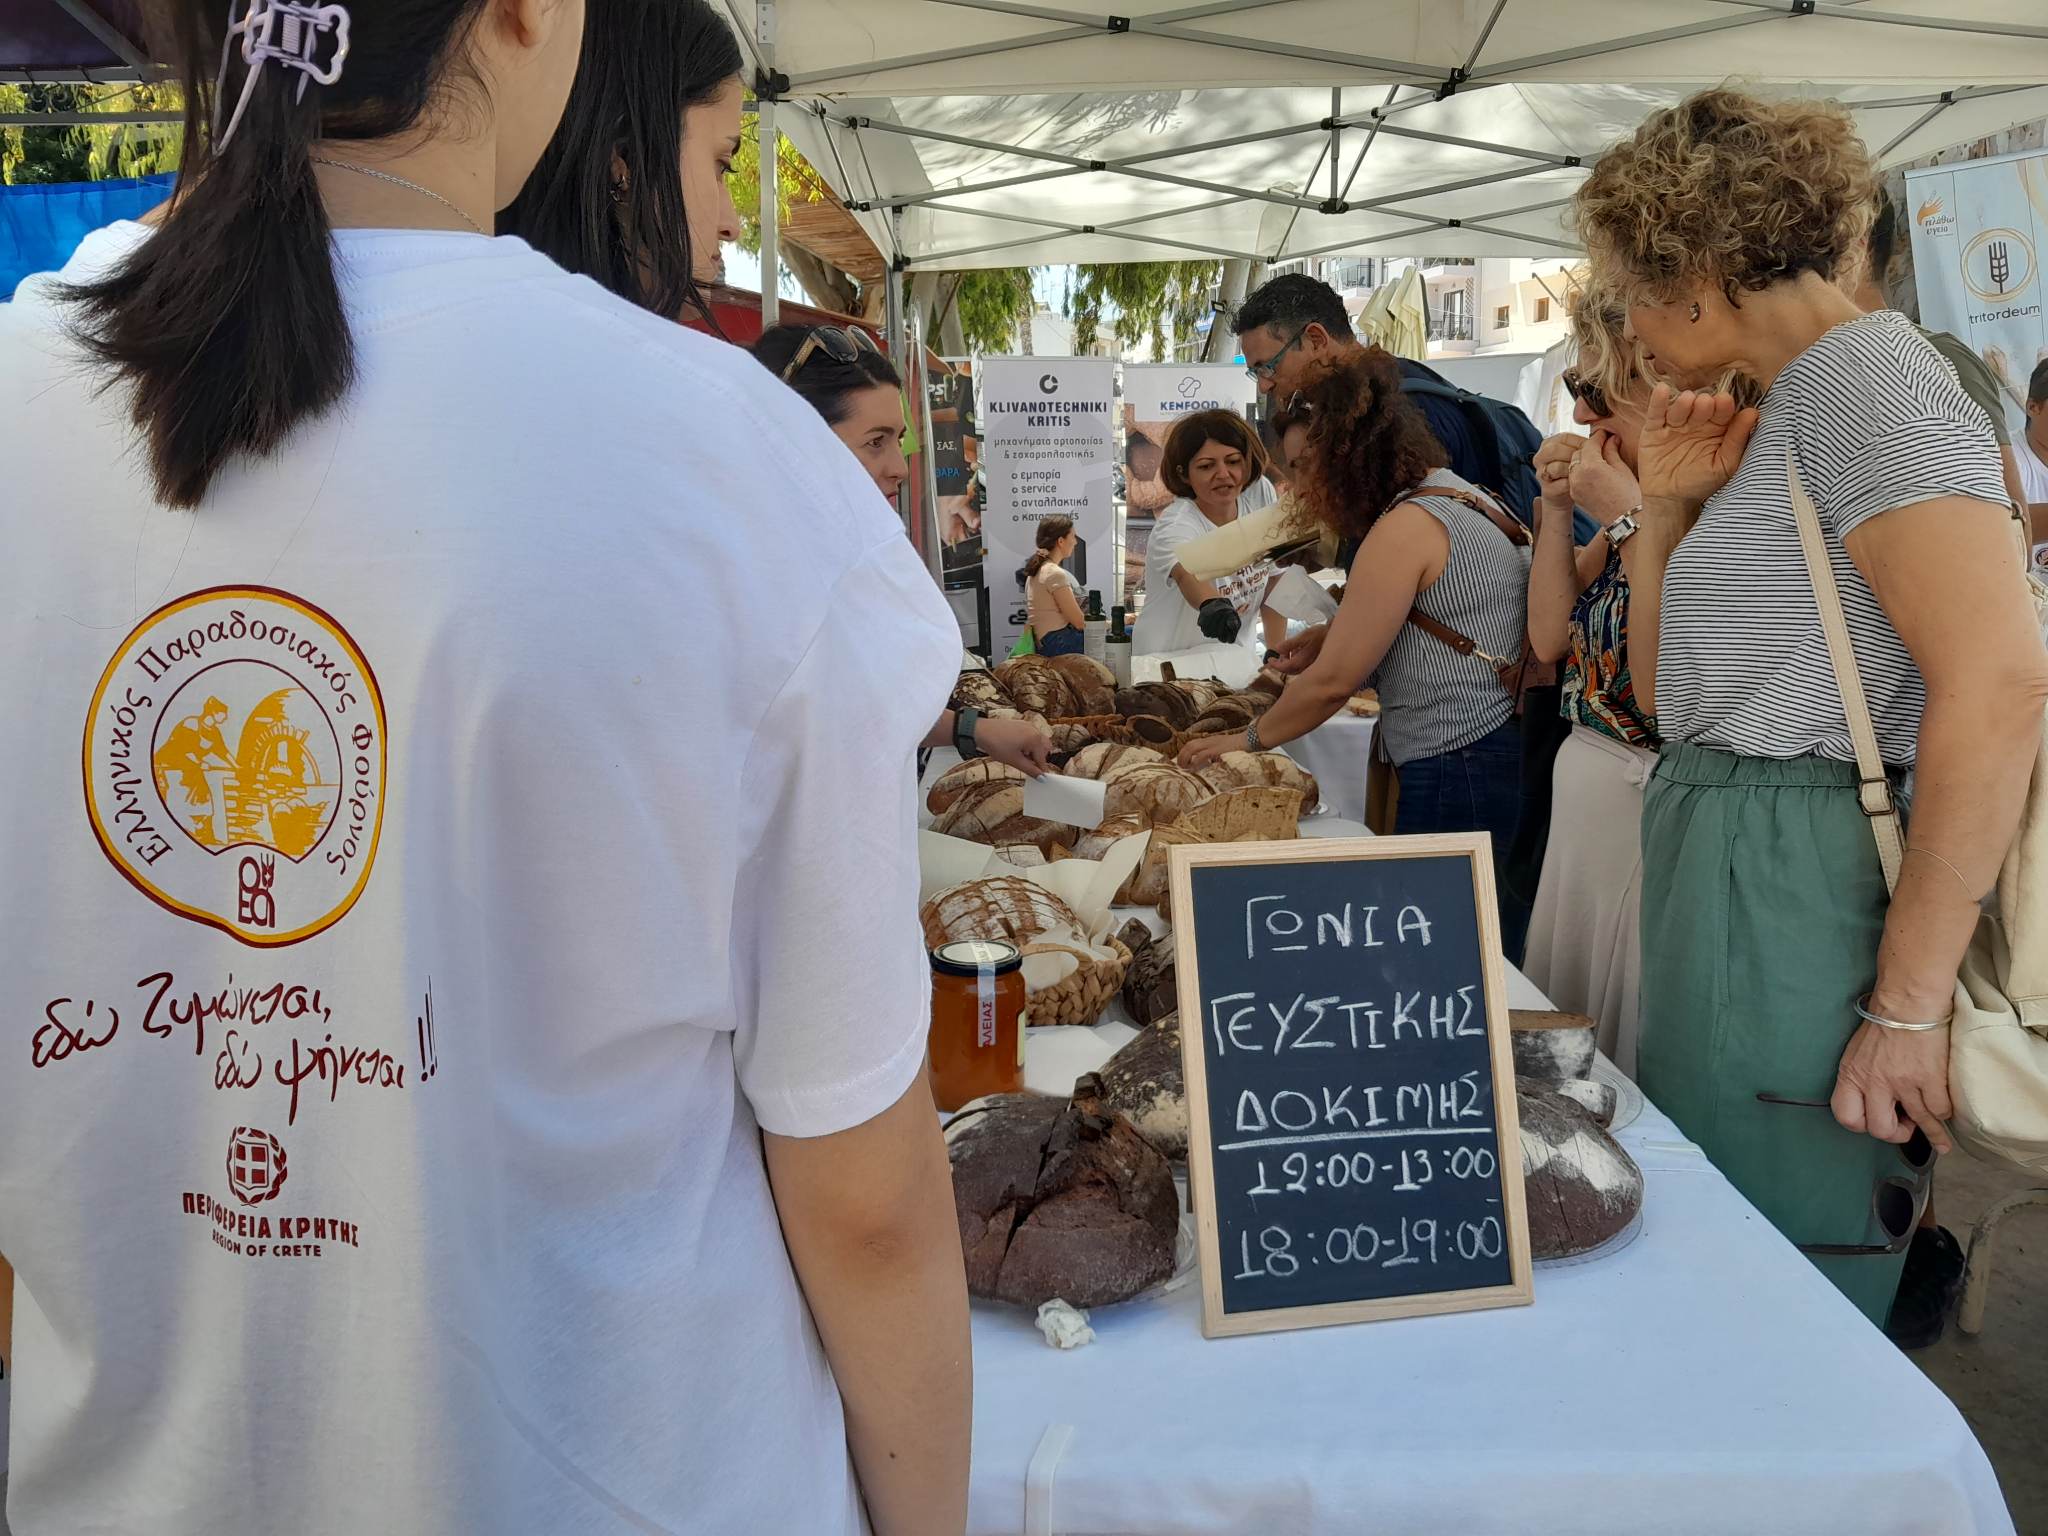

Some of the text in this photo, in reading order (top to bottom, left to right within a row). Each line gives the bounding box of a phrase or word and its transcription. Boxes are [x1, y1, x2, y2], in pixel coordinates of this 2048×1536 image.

[1968, 304, 2040, 325] tritordeum
[989, 401, 1107, 413] KLIVANOTECHNIKI
[1160, 400, 1219, 411] KENFOOD
[1028, 415, 1071, 427] KRITIS
[994, 437, 1051, 448] μηχανήματα
[1012, 449, 1095, 460] ζαχαροπλαστικής
[1020, 469, 1061, 482] εμπορία
[1021, 483, 1057, 493] service
[1021, 496, 1089, 508] ανταλλακτικά
[110, 609, 375, 876] Ελληνικός Παραδοσιακός Φούρνος
[1210, 984, 1485, 1057] ΓΕΥΣΤΙΚΗΣ
[32, 997, 120, 1068] εδώ
[214, 1029, 263, 1090] εδώ
[1235, 1070, 1485, 1133] ΔΟΚΙΜΗΣ
[182, 1192, 359, 1248] ΠΕΡΙΦΕΡΕΙΑ ΚΡΗΤΗΣ
[212, 1229, 322, 1257] REGION OF CRETE
